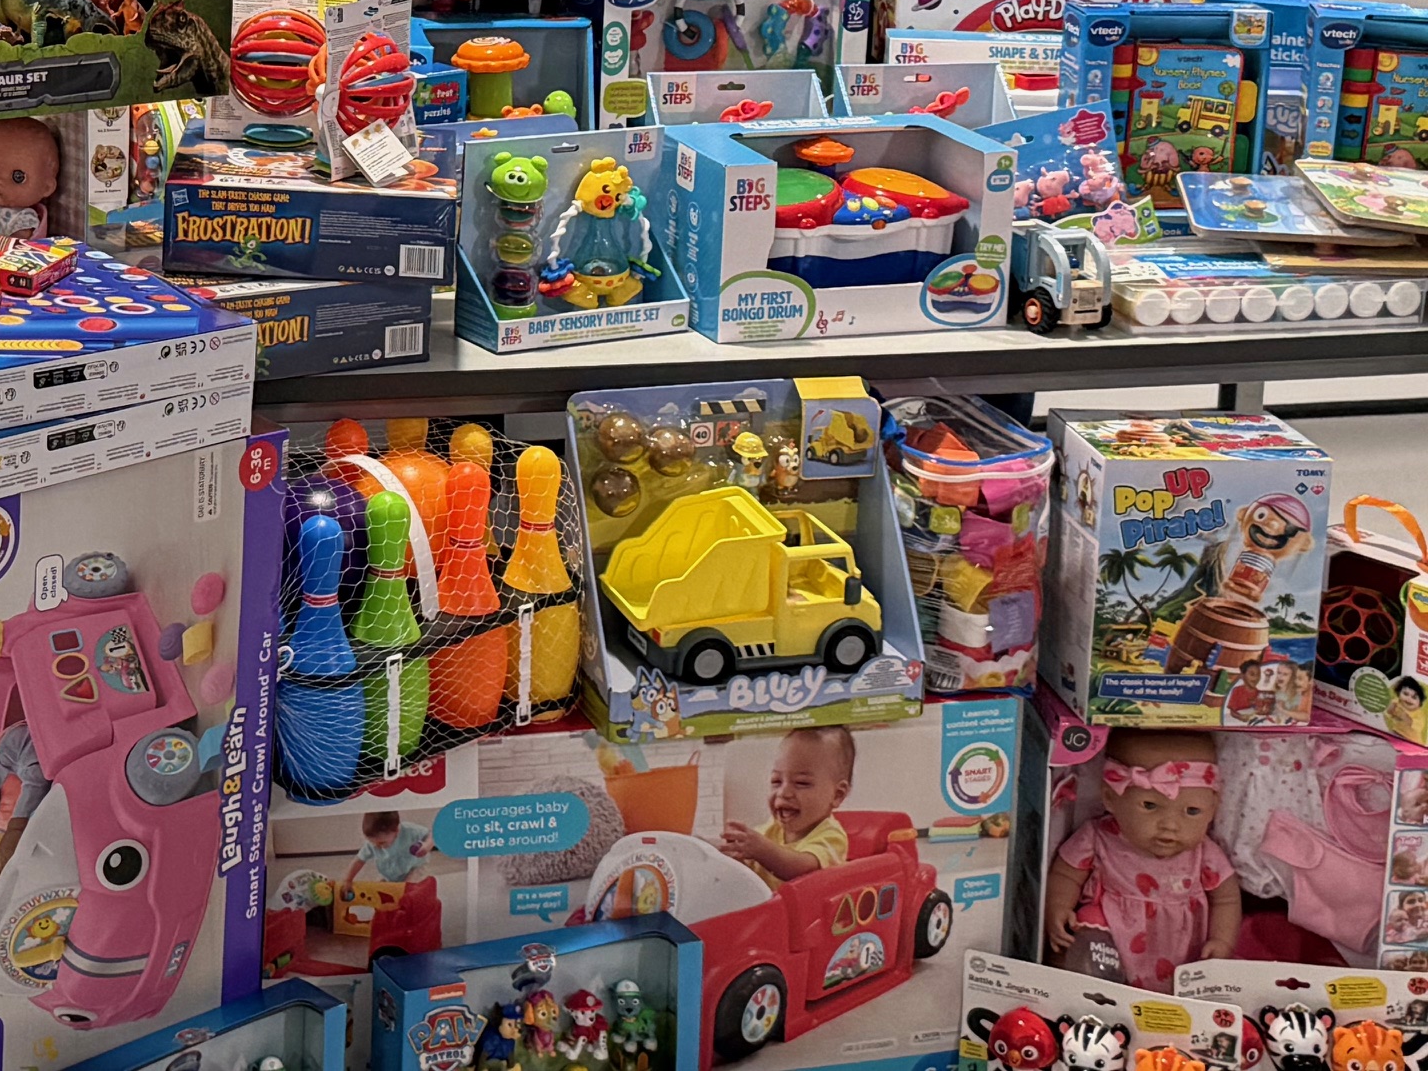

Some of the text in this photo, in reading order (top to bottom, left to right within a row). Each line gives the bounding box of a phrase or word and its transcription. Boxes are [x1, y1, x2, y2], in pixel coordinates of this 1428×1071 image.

[1090, 24, 1123, 35] vtech
[1323, 29, 1357, 39] vtech
[989, 46, 1040, 59] SHAPE &
[26, 70, 48, 85] SET
[1191, 66, 1227, 79] Rhymes
[850, 85, 879, 97] STEPS
[662, 92, 693, 105] STEPS
[424, 107, 451, 120] puzzles
[628, 142, 653, 154] STEPS
[211, 190, 290, 203] SLAM-TASTIC CHASING GAME
[729, 193, 772, 212] STEPS
[175, 211, 312, 244] FRUSTRATION!
[978, 243, 994, 254] TRY
[737, 290, 793, 306] MY FIRST
[722, 304, 803, 322] BONGO DRUM
[528, 319, 557, 335] BABY
[559, 314, 604, 332] SENSORY
[605, 310, 642, 326] RATTLE
[643, 308, 660, 321] SET
[501, 334, 522, 346] STEPS
[694, 431, 708, 440] 40
[250, 447, 262, 484] 6-36
[1296, 469, 1325, 477] TOMY
[1113, 467, 1211, 519] Pop UP
[1120, 499, 1227, 549] Pirate!
[729, 666, 826, 712] BLUEY
[1120, 678, 1202, 689] classic barrel laughs
[1157, 688, 1184, 697] family!
[962, 709, 1000, 718] Learning
[946, 718, 1015, 729] content changes
[1064, 732, 1087, 749] JC
[246, 631, 273, 918] Smart Crawl Car
[965, 767, 992, 777] SMART
[455, 801, 569, 820] Encourages baby
[466, 817, 558, 834] to sit, crawl &
[464, 832, 559, 850] cruise around!
[1033, 988, 1050, 999] Trio
[407, 1014, 489, 1054] PAW
[425, 1050, 467, 1064] PATROL
